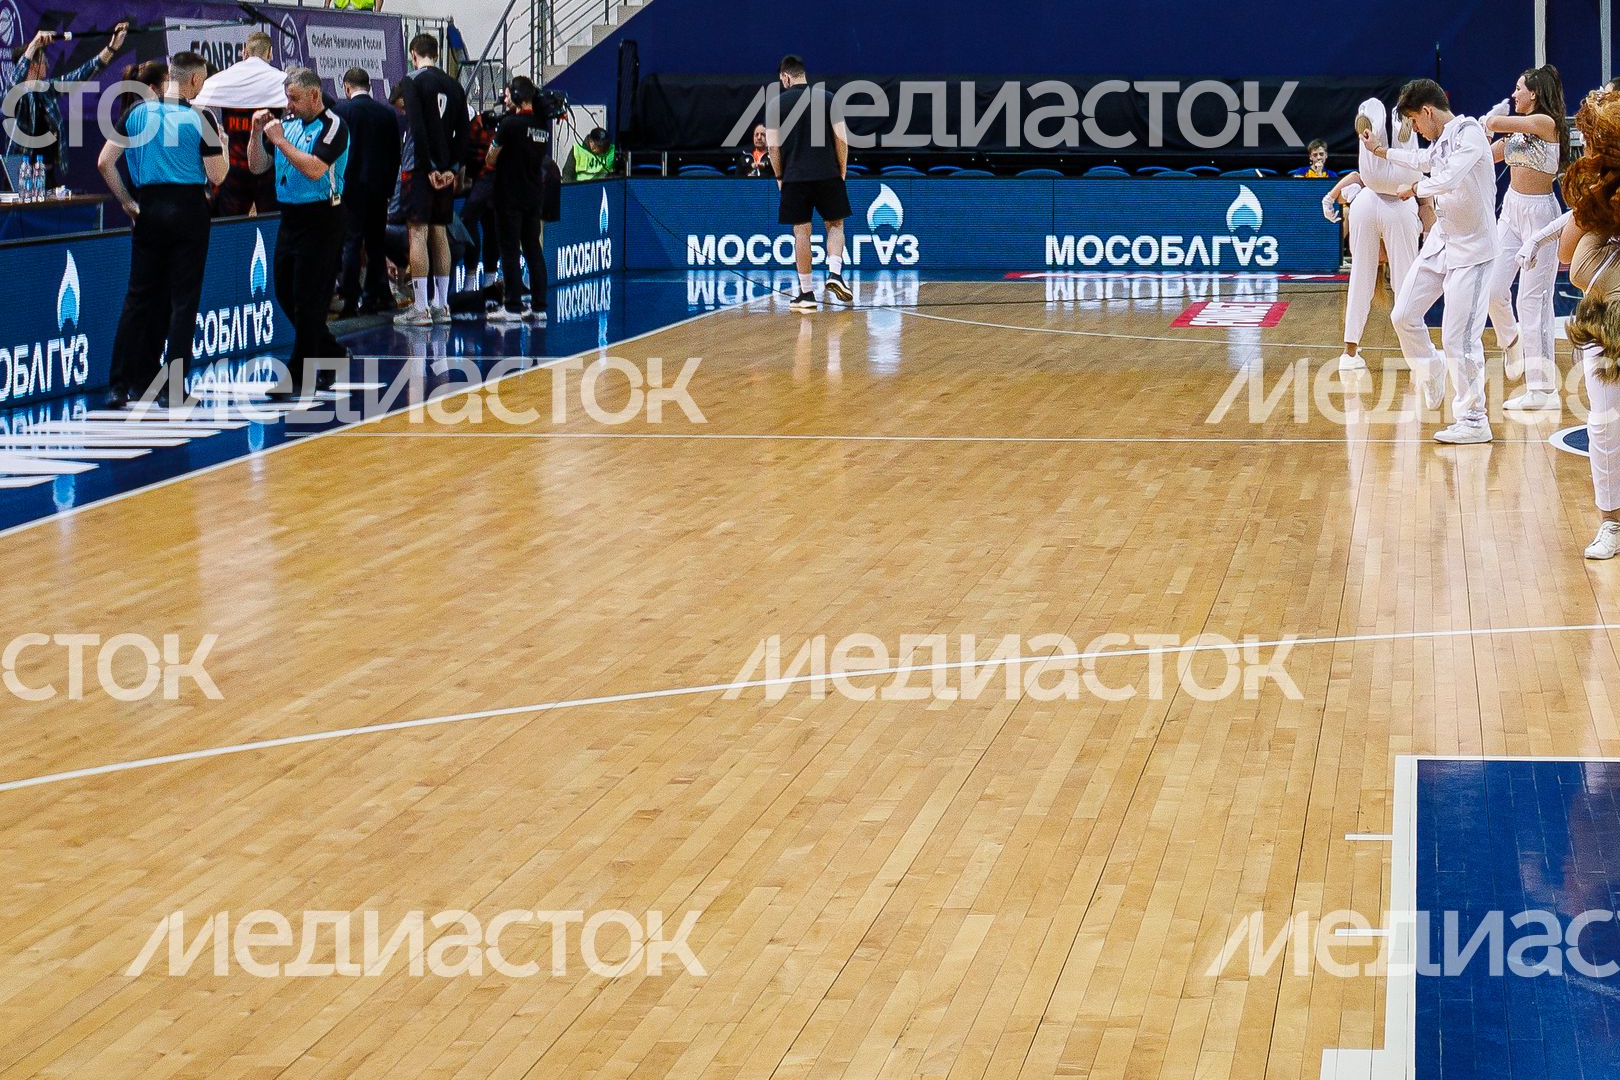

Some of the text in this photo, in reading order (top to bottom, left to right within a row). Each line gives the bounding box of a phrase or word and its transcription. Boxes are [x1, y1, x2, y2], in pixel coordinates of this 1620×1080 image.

[557, 237, 612, 280] МОСОБЛГАЗ
[687, 234, 920, 265] МОСОБГАЗ
[1045, 235, 1279, 266] МОСОБЛГАЗ
[188, 300, 274, 360] СОБЛГАЗ
